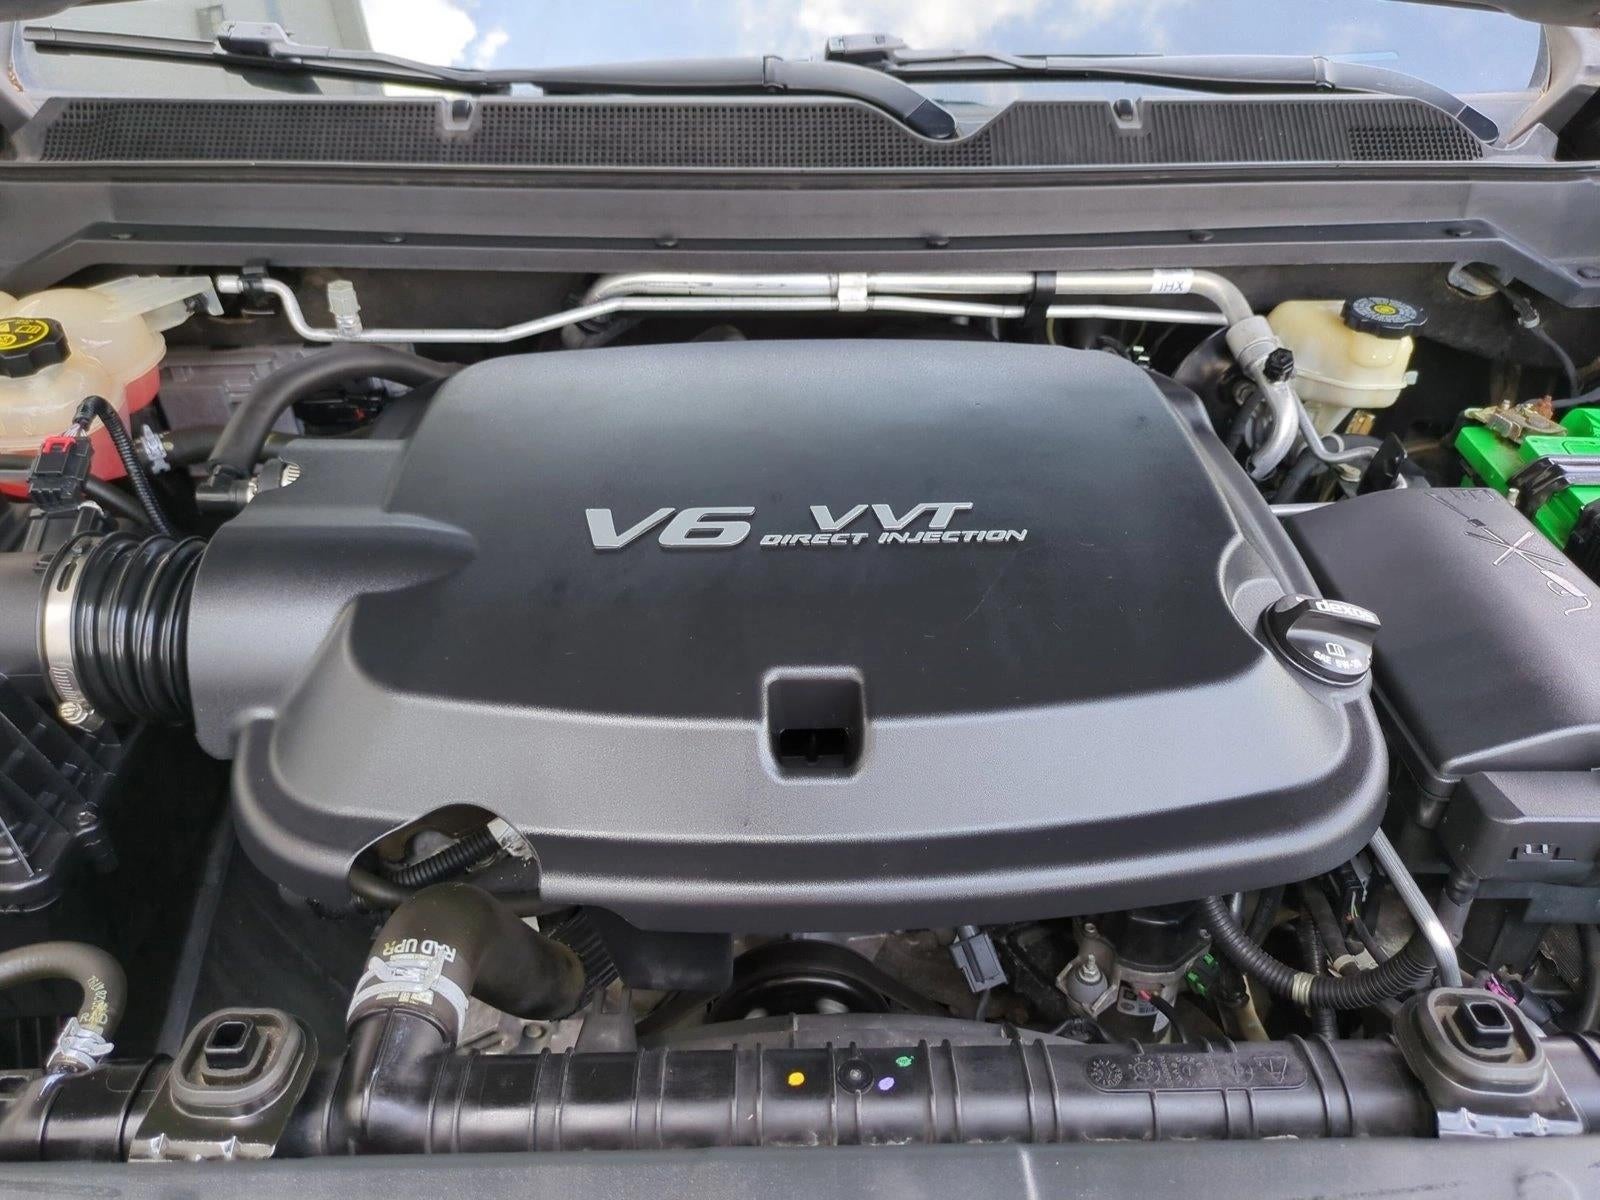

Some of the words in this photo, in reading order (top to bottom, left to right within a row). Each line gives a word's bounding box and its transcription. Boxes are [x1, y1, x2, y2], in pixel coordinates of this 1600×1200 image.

[810, 502, 974, 531] VVT
[585, 506, 756, 550] V6
[760, 532, 869, 546] DIRECT
[877, 528, 1028, 545] INJECTION
[1315, 599, 1375, 622] dexos
[1313, 650, 1332, 664] SAE
[383, 938, 419, 956] UPR
